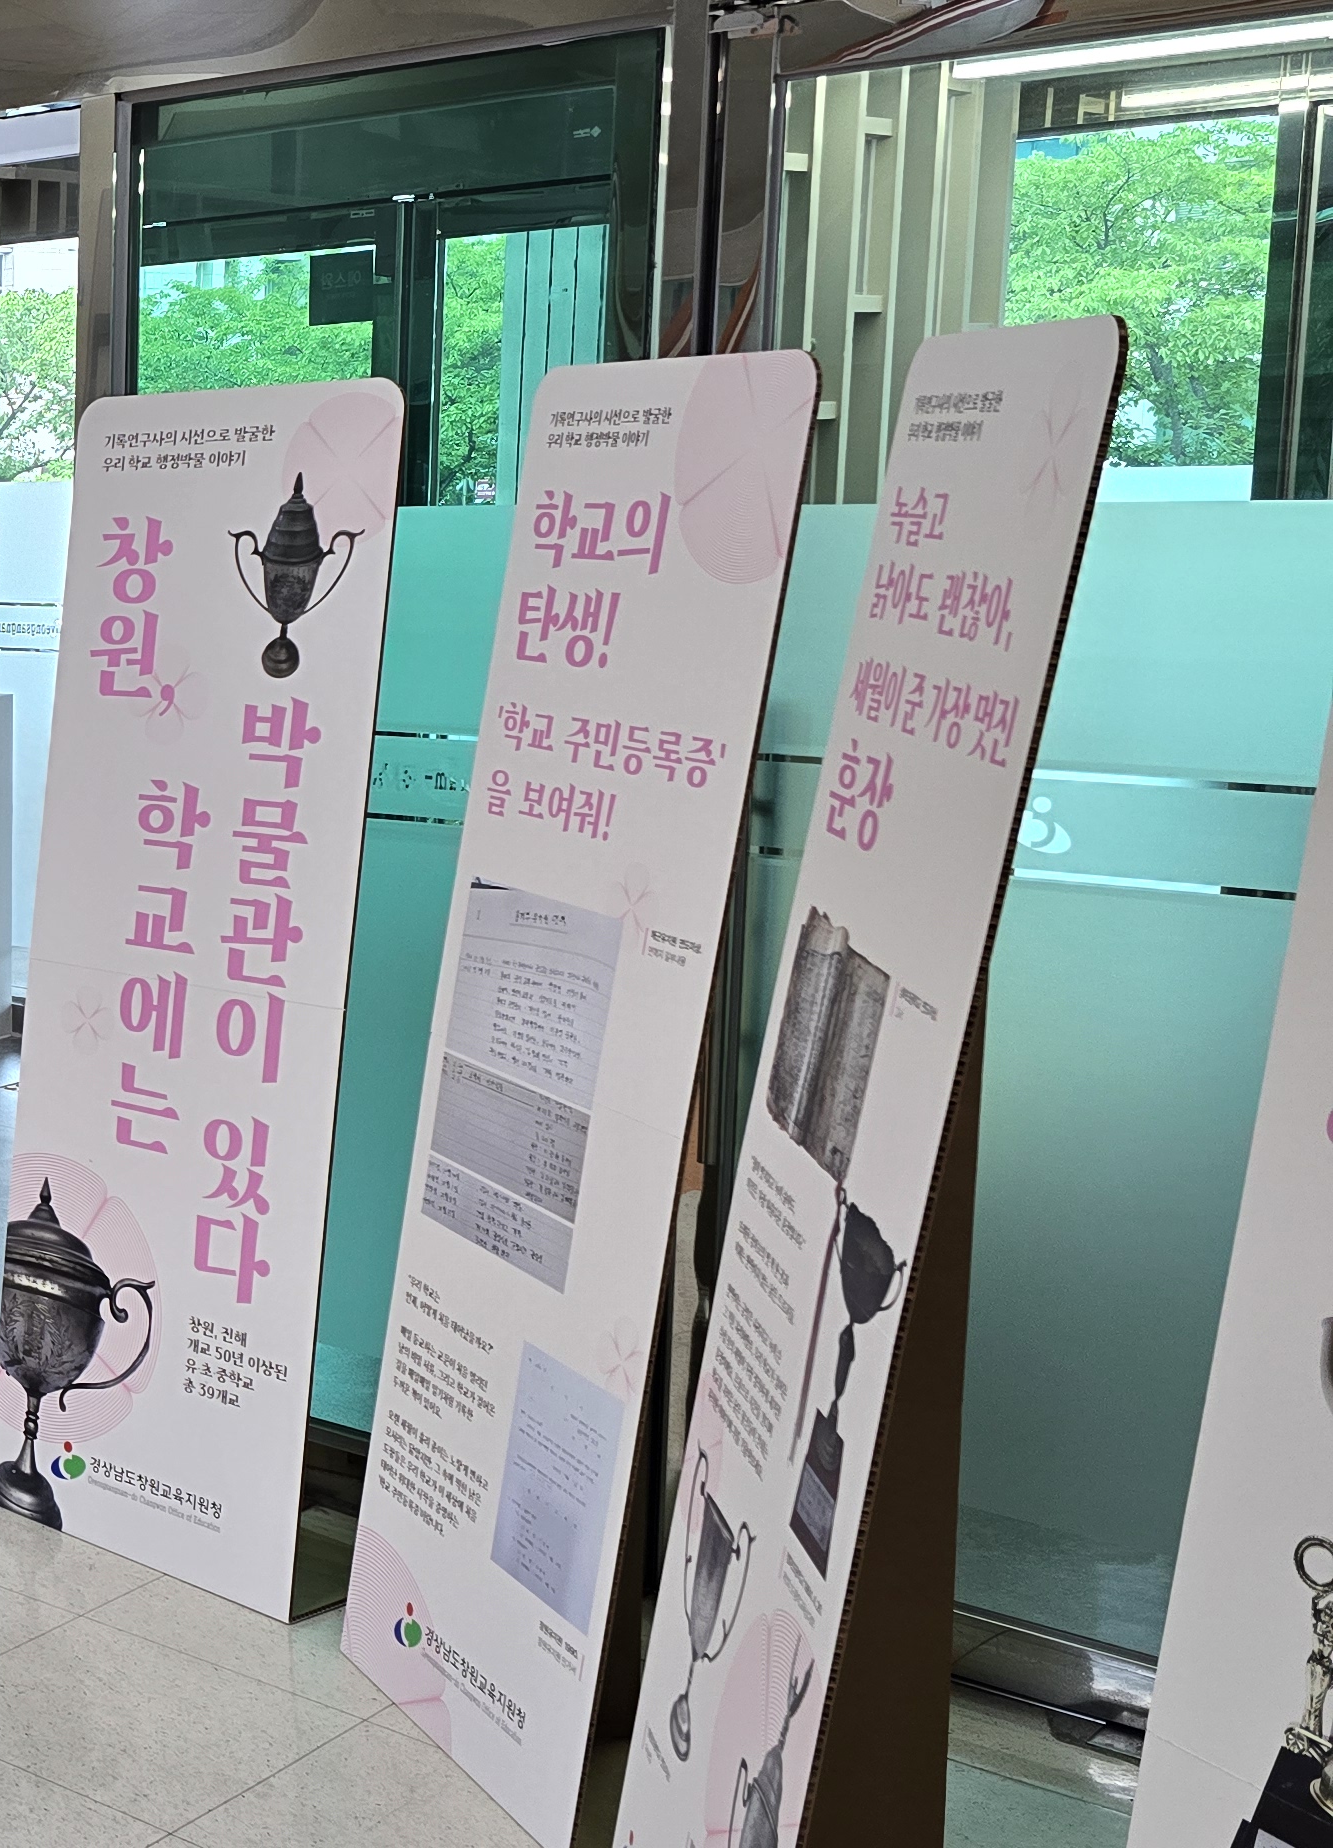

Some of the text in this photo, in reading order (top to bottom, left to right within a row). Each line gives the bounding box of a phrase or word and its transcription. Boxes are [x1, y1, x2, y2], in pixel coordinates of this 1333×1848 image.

[104, 425, 276, 448] 기록연구사의 시선으로 발굴한
[546, 430, 649, 448] 우리 학교 행정박물 이야기
[550, 407, 672, 427] 기록연구사의 시선으로 발굴한
[102, 450, 246, 472] 우리 학교 행정박물 이야기
[533, 490, 671, 575] 학교의
[890, 486, 949, 547] 녹슬고
[90, 516, 175, 716] 창원,
[516, 584, 621, 668] 탄생!
[869, 561, 1013, 652] 낡아도 괜찮아,
[498, 702, 726, 788] '학교 주민등록증'
[849, 657, 1020, 768] 세월이 준 가장 멋진
[487, 770, 512, 817] 을
[518, 780, 616, 841] 보여줘!
[826, 738, 894, 852] 훈장
[216, 696, 322, 1083] 박물관이
[111, 779, 211, 1155] 학교에는
[194, 1116, 270, 1304] 있다
[187, 1337, 288, 1382] 개교 50년 이상된
[188, 1316, 248, 1348] 창원, 진해
[183, 1377, 242, 1408] 총 39개교
[89, 1457, 223, 1519] 경상남도창원교육지원청
[425, 1626, 526, 1730] 경상남도창원교육지원청
